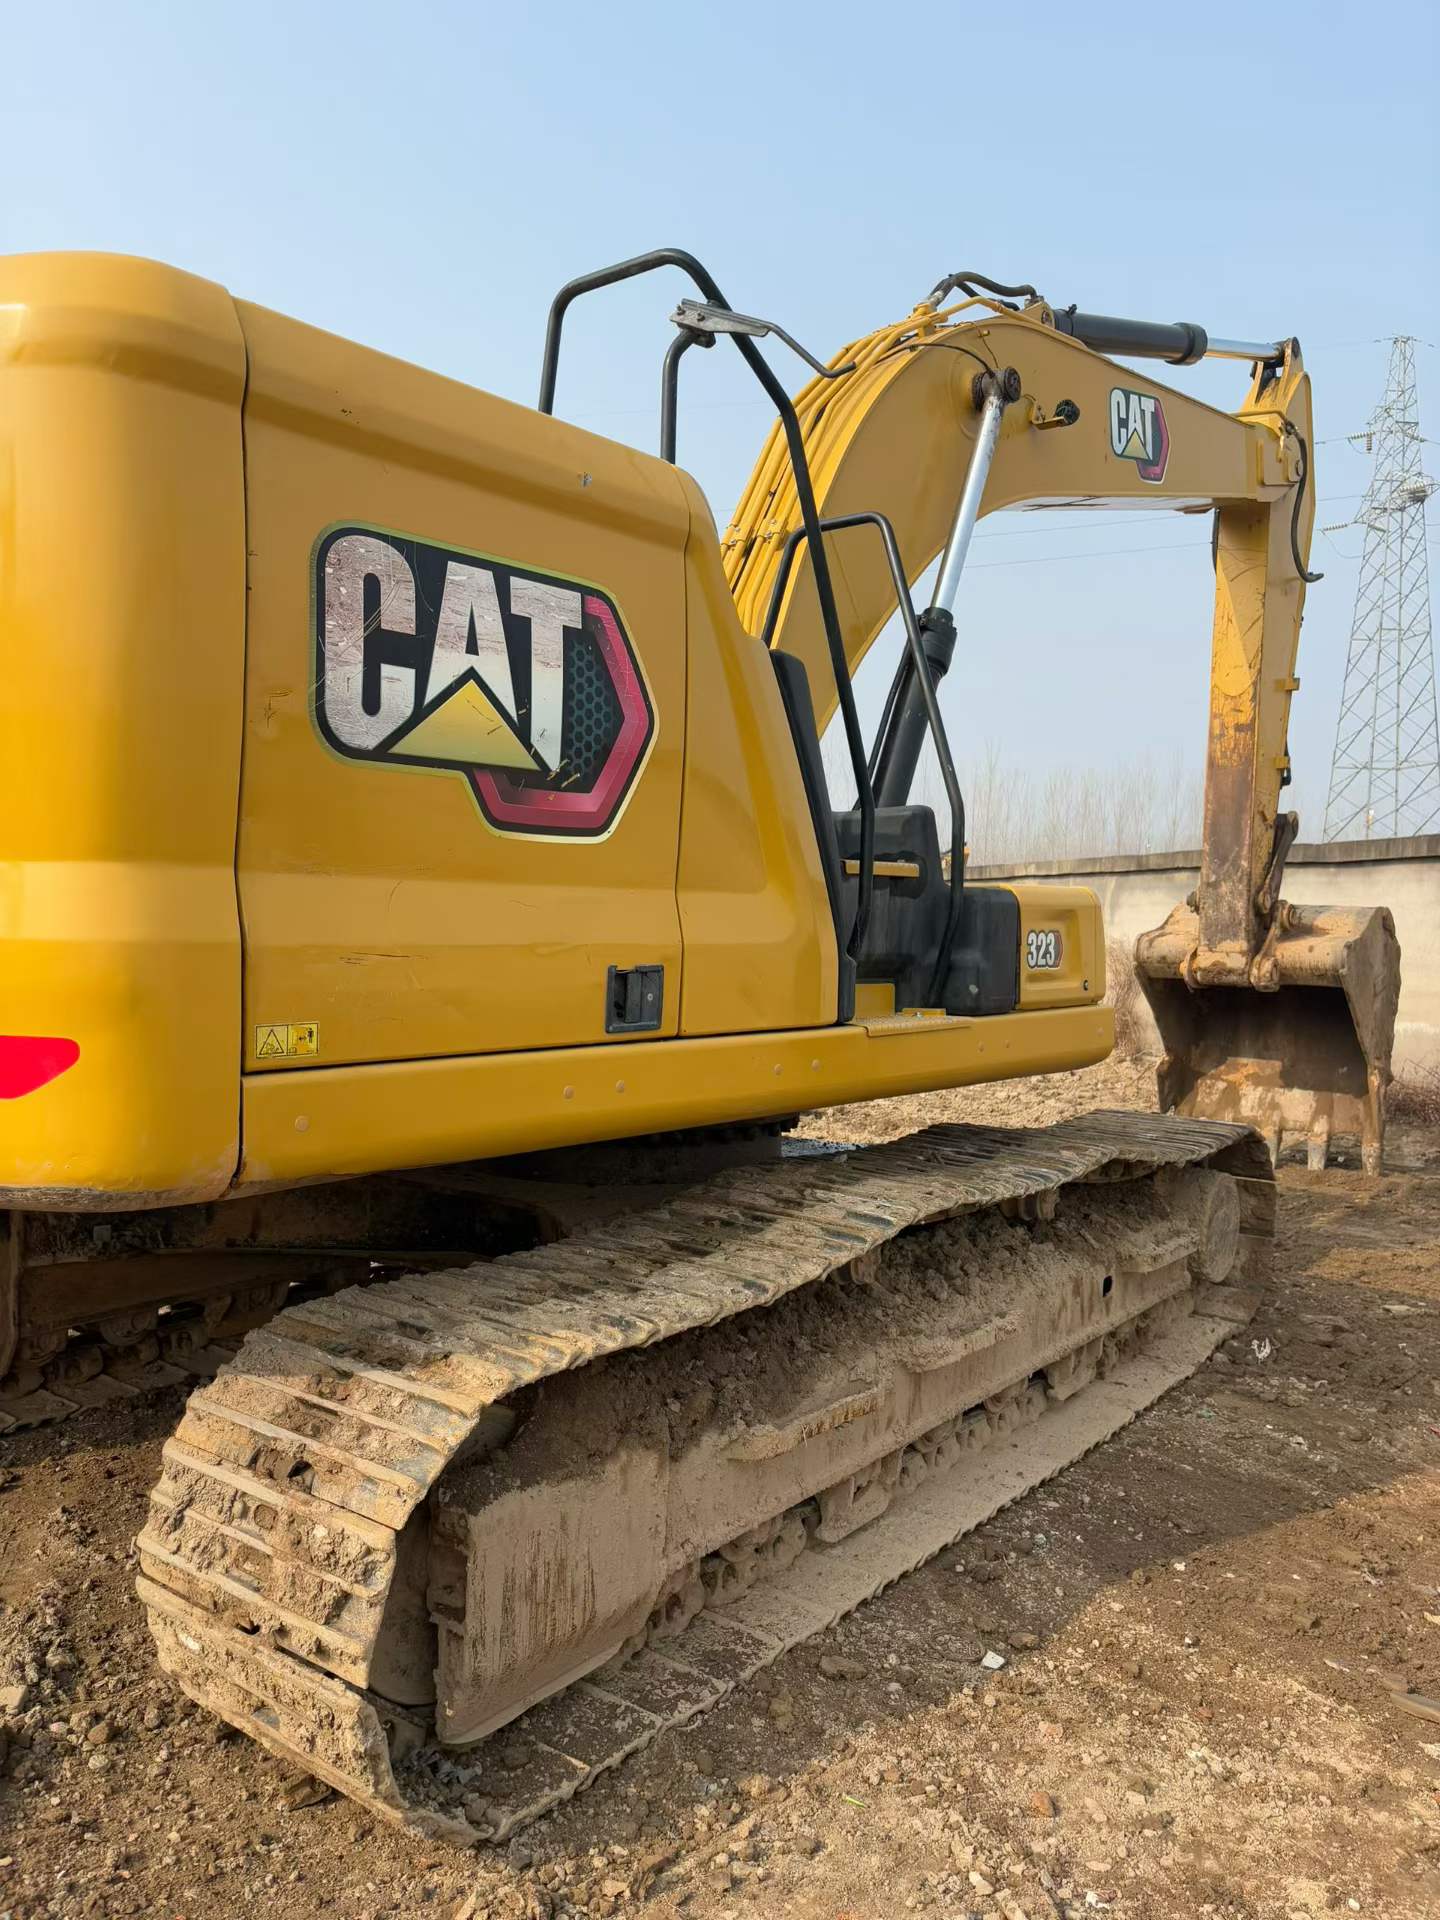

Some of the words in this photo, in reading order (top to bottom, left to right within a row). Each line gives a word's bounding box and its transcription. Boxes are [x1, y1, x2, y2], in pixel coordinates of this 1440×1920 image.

[1111, 389, 1155, 460] CAT
[325, 535, 582, 771] CAT
[1028, 932, 1055, 966] 323
